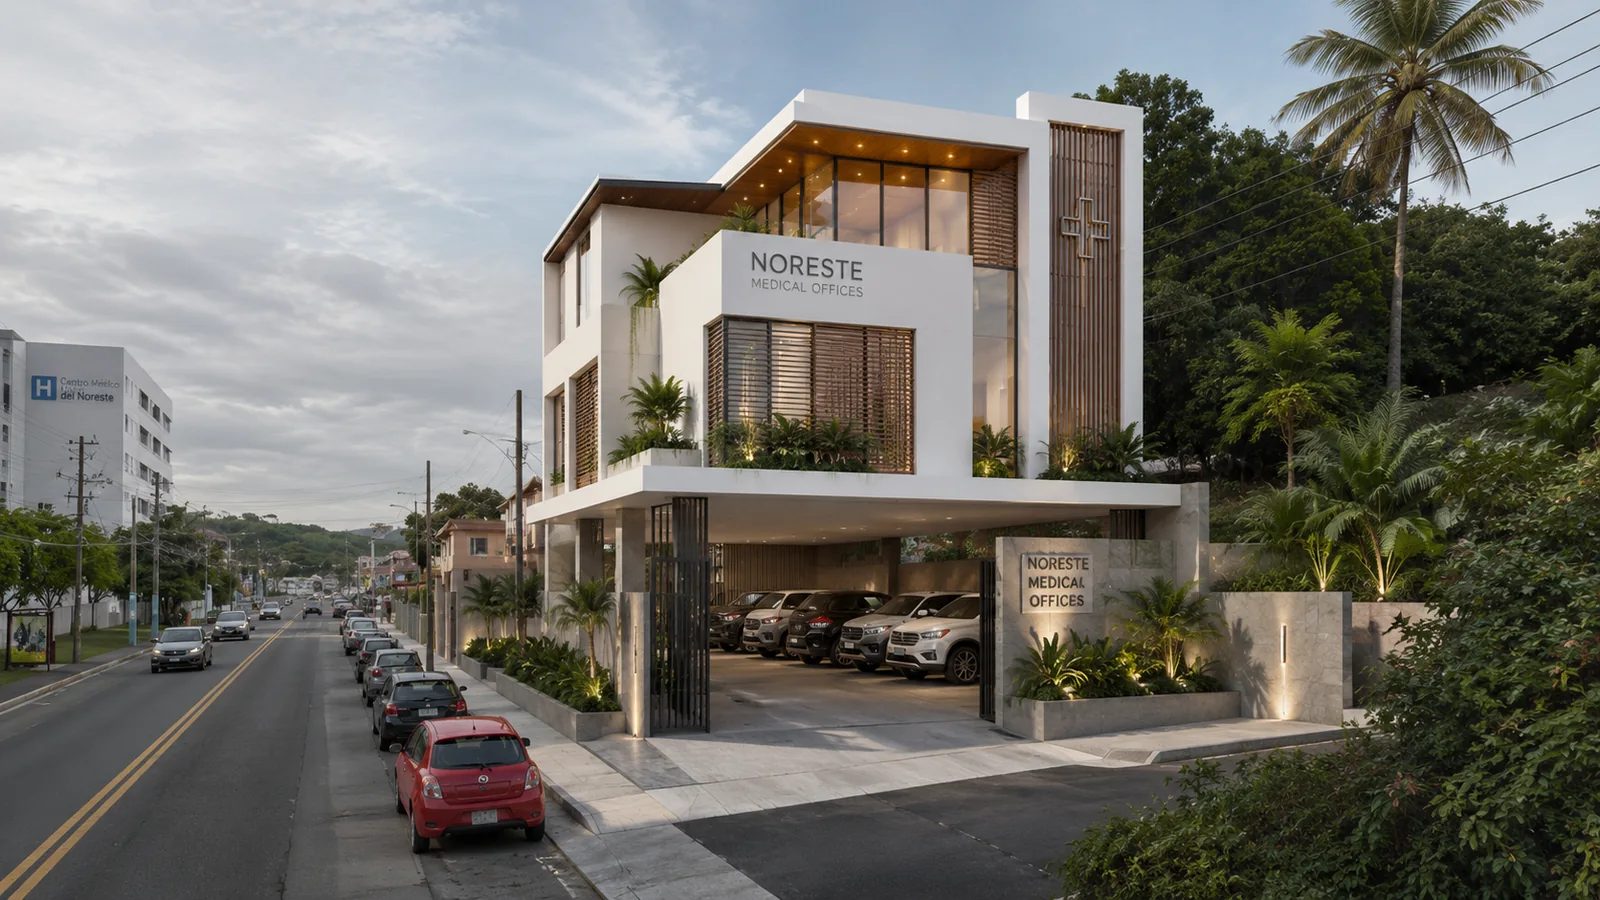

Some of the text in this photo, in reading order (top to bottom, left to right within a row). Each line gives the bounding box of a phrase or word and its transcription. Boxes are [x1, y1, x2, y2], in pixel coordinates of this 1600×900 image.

[751, 251, 863, 281] NORESTE
[751, 278, 864, 298] MEDICAL OFFICES
[60, 377, 89, 387] Centro
[60, 390, 114, 402] del Noreste
[1027, 557, 1089, 570] NORESTE
[1028, 576, 1085, 588] MEDICAL
[1029, 594, 1084, 607] OFFICES
